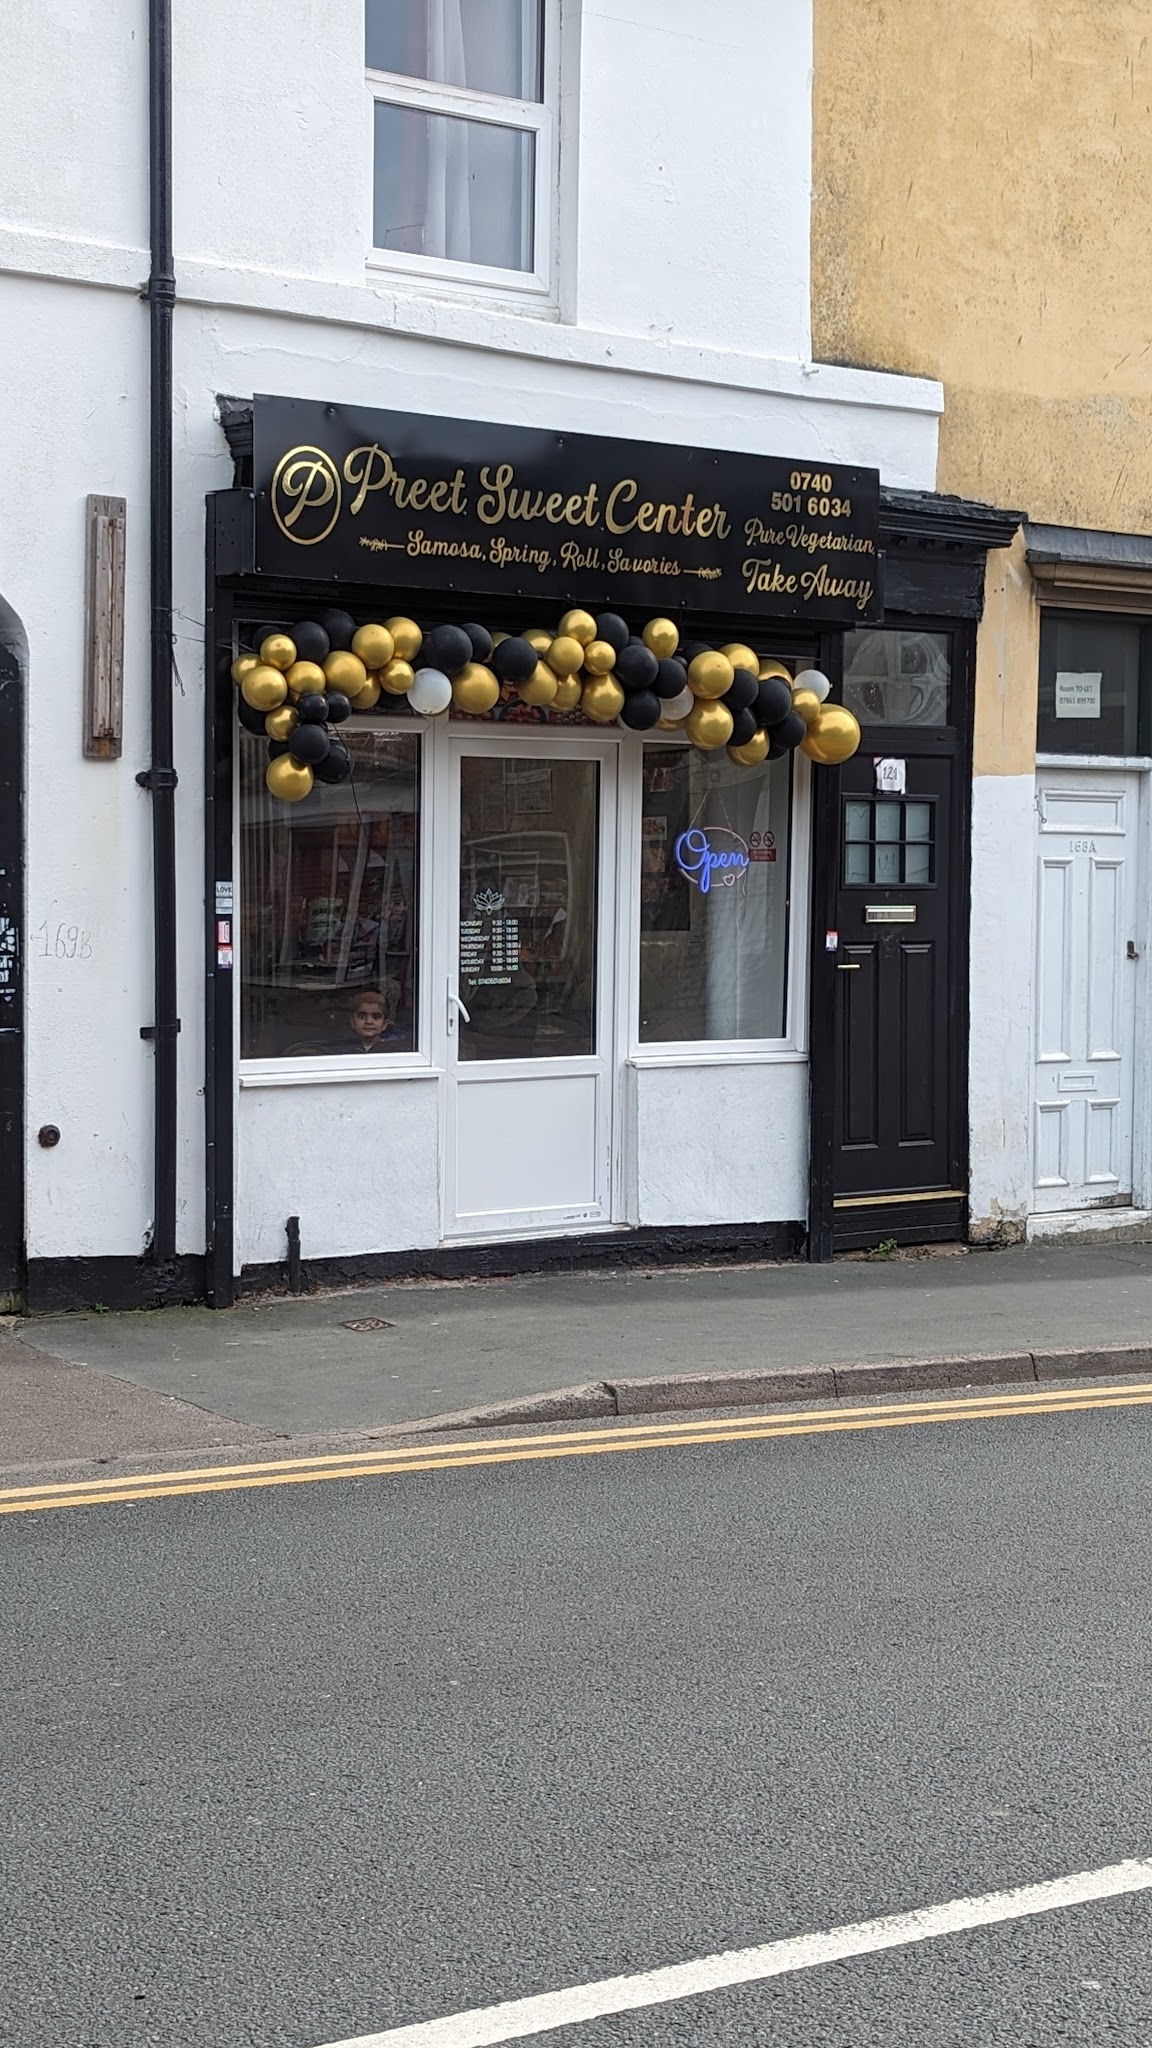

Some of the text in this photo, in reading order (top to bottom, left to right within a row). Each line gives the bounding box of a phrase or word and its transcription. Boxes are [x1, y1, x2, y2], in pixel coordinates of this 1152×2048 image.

[344, 443, 731, 540] Preet Sweet Center
[771, 491, 852, 517] 501 6034
[790, 471, 832, 493] 0740
[407, 529, 681, 576] Samosa, Spring, Roll, Savories
[744, 517, 785, 547] Pure
[742, 558, 873, 610] Take Away
[676, 829, 749, 893] Open
